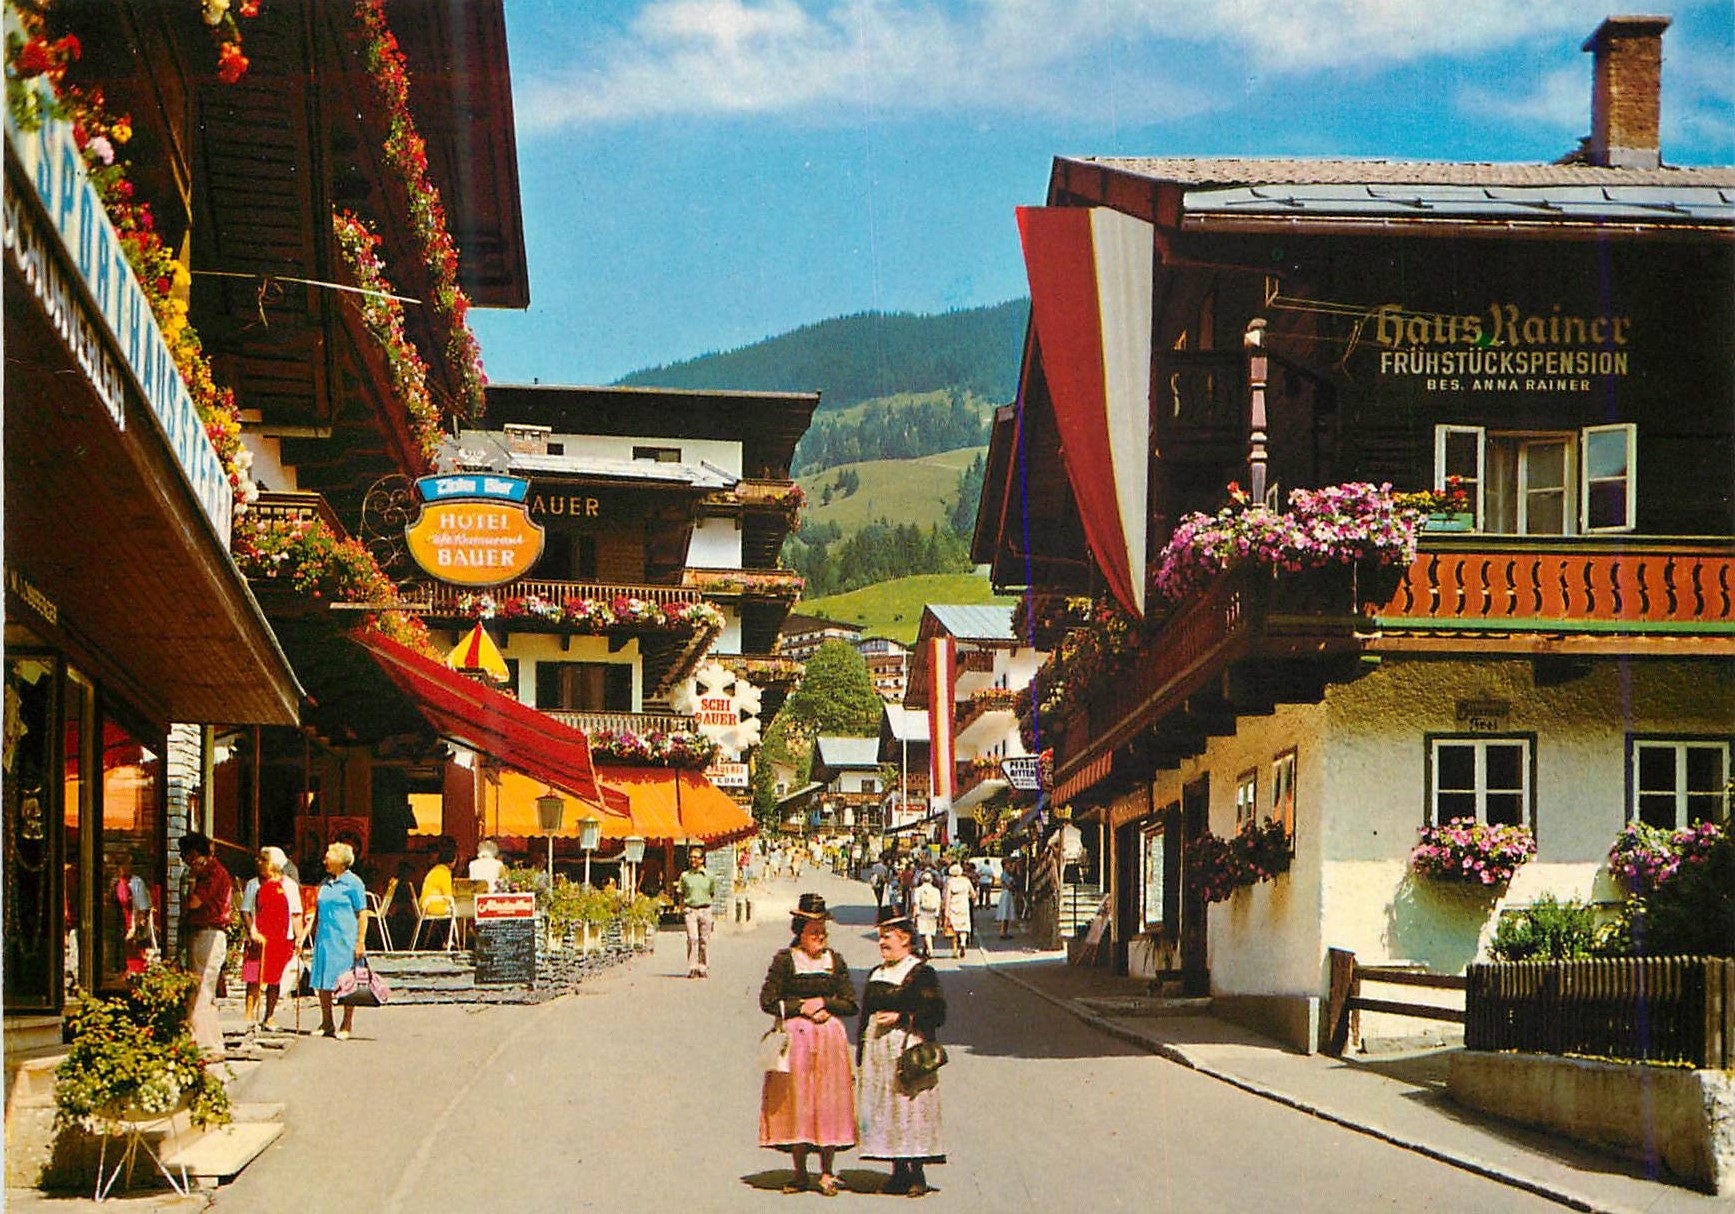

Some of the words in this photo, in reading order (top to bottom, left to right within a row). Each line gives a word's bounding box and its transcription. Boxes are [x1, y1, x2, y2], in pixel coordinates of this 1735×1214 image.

[1376, 303, 1483, 347] Haus
[1488, 303, 1632, 347] Rainer
[1380, 345, 1628, 375] FRÜHSTÜCKSPENSION
[1426, 379, 1465, 391] BES.
[1472, 379, 1519, 391] ANNA
[1526, 379, 1591, 391] RAINER
[527, 493, 600, 518] AUER
[440, 513, 509, 530] HOTEL
[438, 549, 515, 567] BAUER
[701, 698, 731, 712] SCHI
